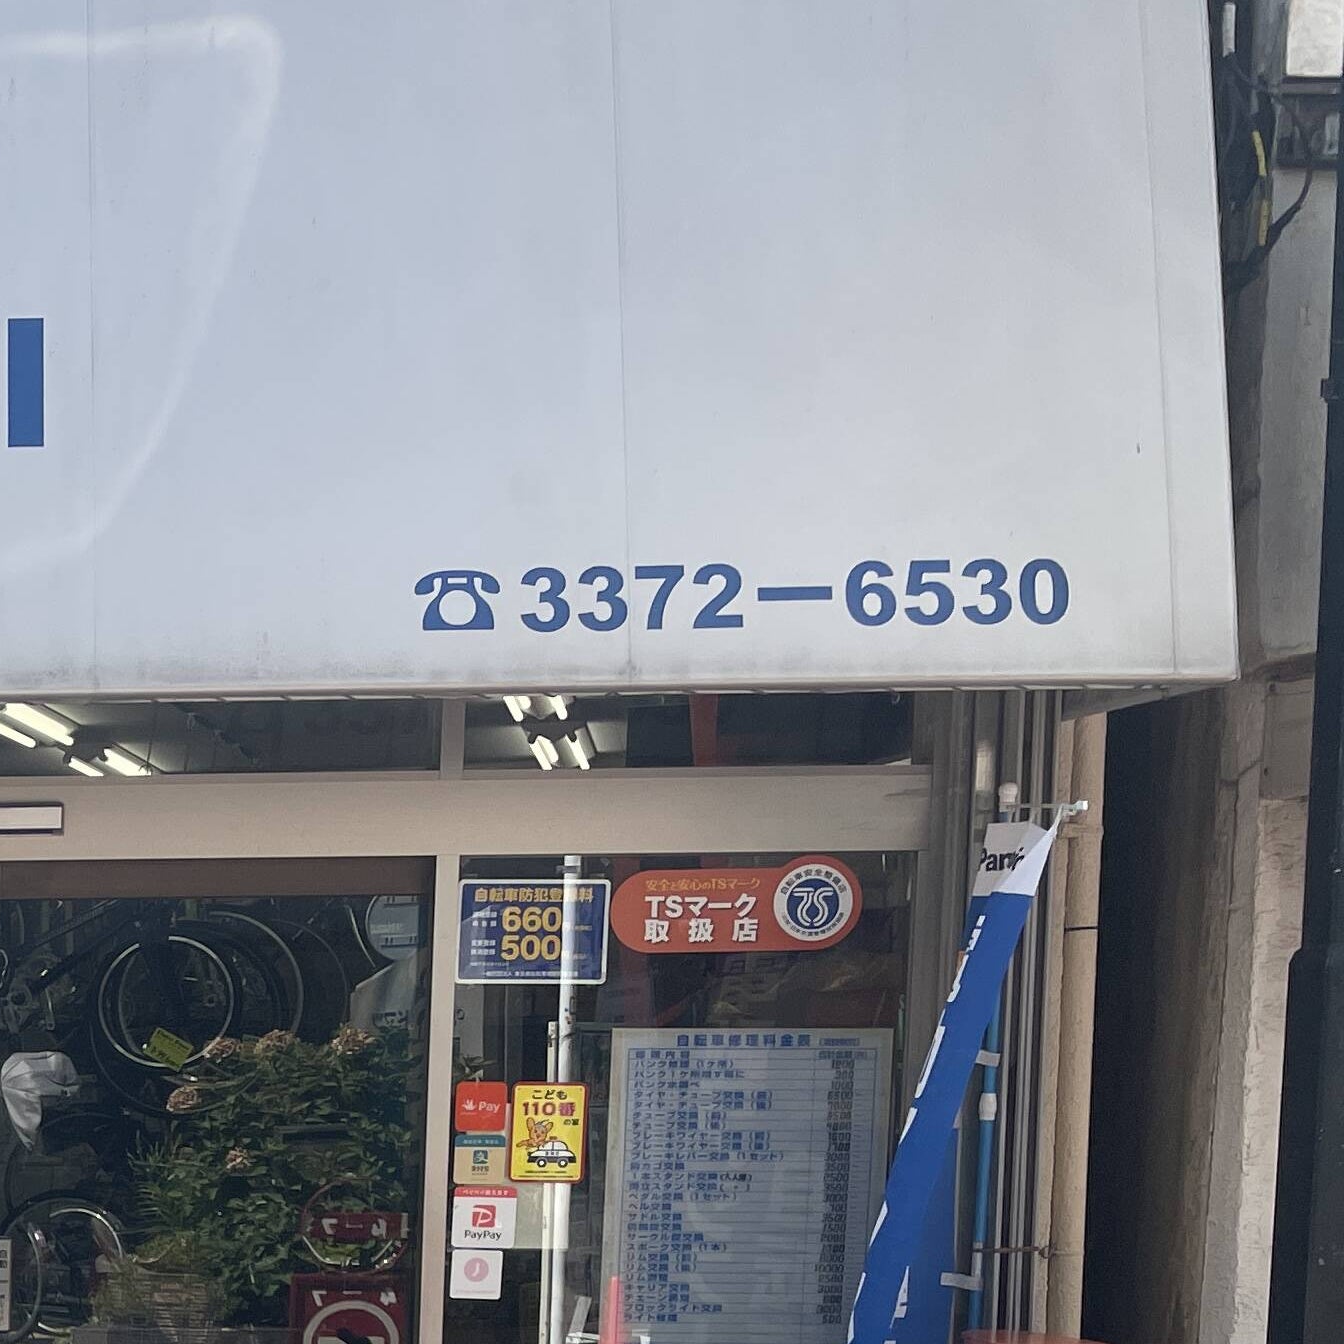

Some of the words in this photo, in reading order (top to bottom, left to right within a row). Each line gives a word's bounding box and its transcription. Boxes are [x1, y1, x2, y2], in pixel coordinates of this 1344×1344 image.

[644, 893, 758, 918] TSマーク
[501, 905, 562, 933] 660
[644, 917, 759, 944] 取扱店
[500, 934, 562, 961] 500
[478, 1101, 501, 1113] Pay
[532, 1089, 568, 1100] こども
[464, 1229, 502, 1241] PayPay
